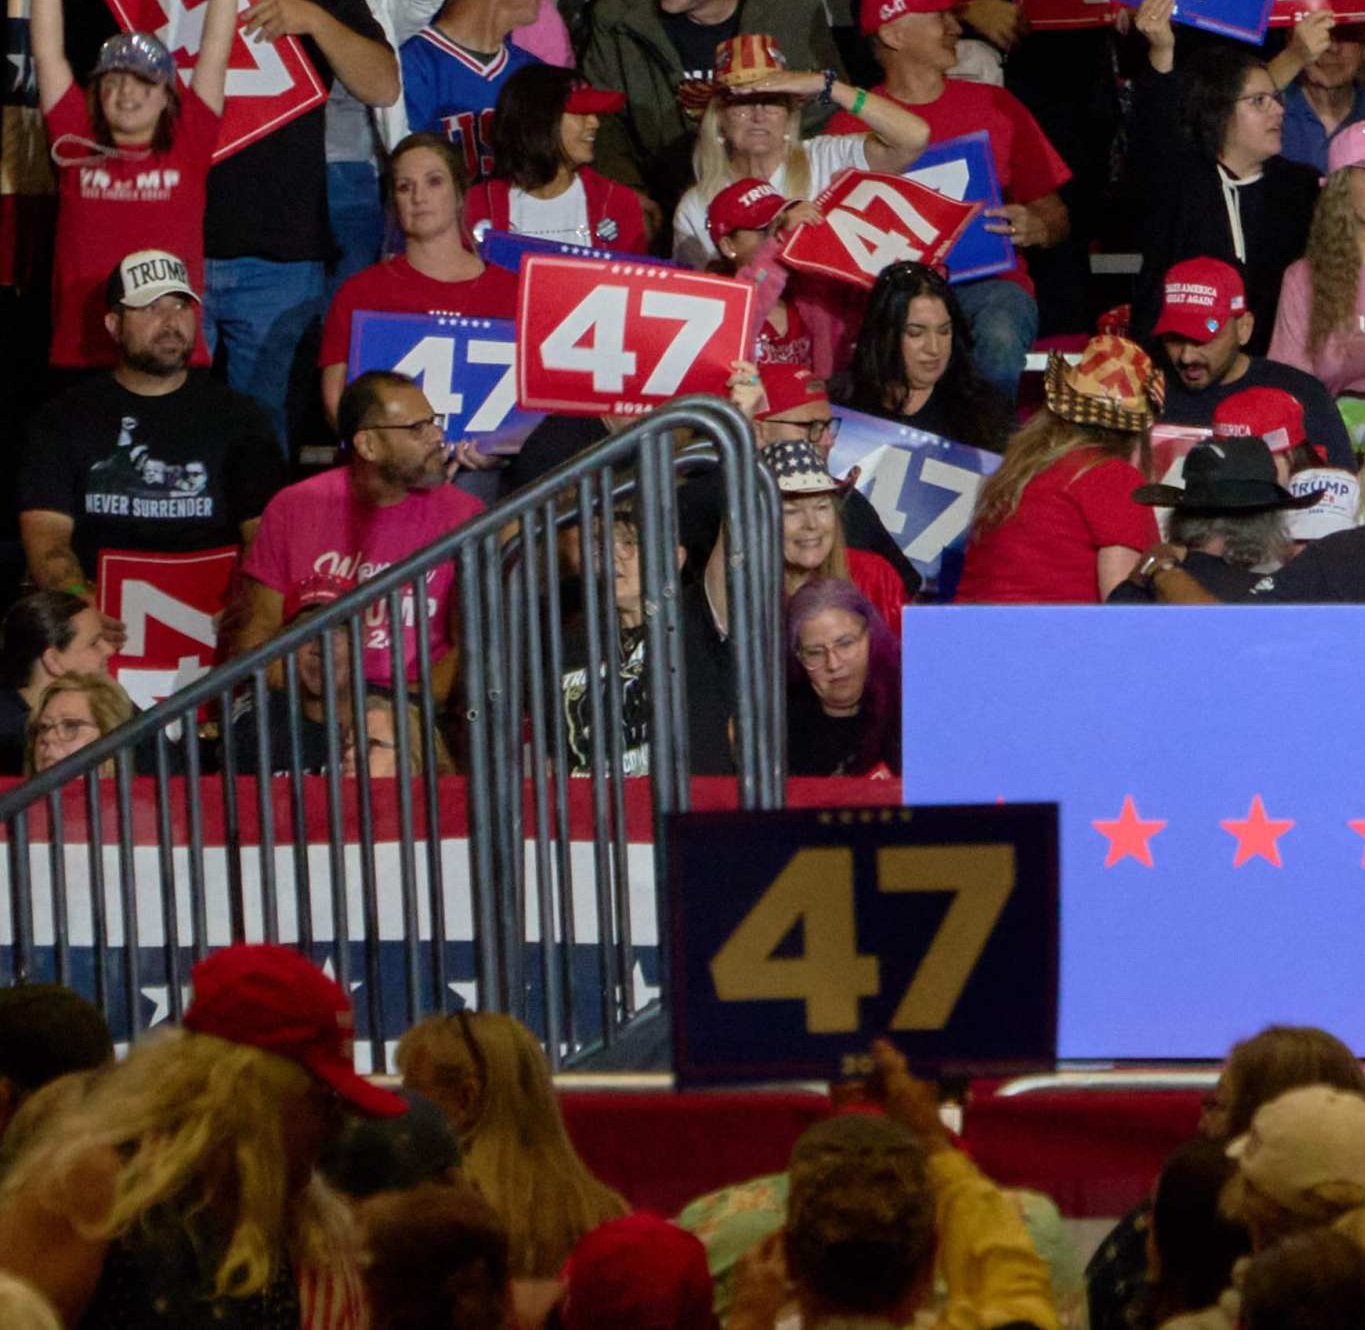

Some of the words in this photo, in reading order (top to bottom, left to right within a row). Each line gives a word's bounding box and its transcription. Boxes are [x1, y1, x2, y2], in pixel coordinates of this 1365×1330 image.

[828, 178, 940, 272] 47
[1183, 284, 1217, 298] AMERICA
[1187, 295, 1214, 306] AGAIN
[390, 336, 517, 432] 47
[540, 285, 725, 395] 47
[86, 494, 129, 516] NEVER
[133, 497, 213, 519] SURRENDER
[853, 448, 982, 561] 47
[709, 844, 1016, 1035] 47
